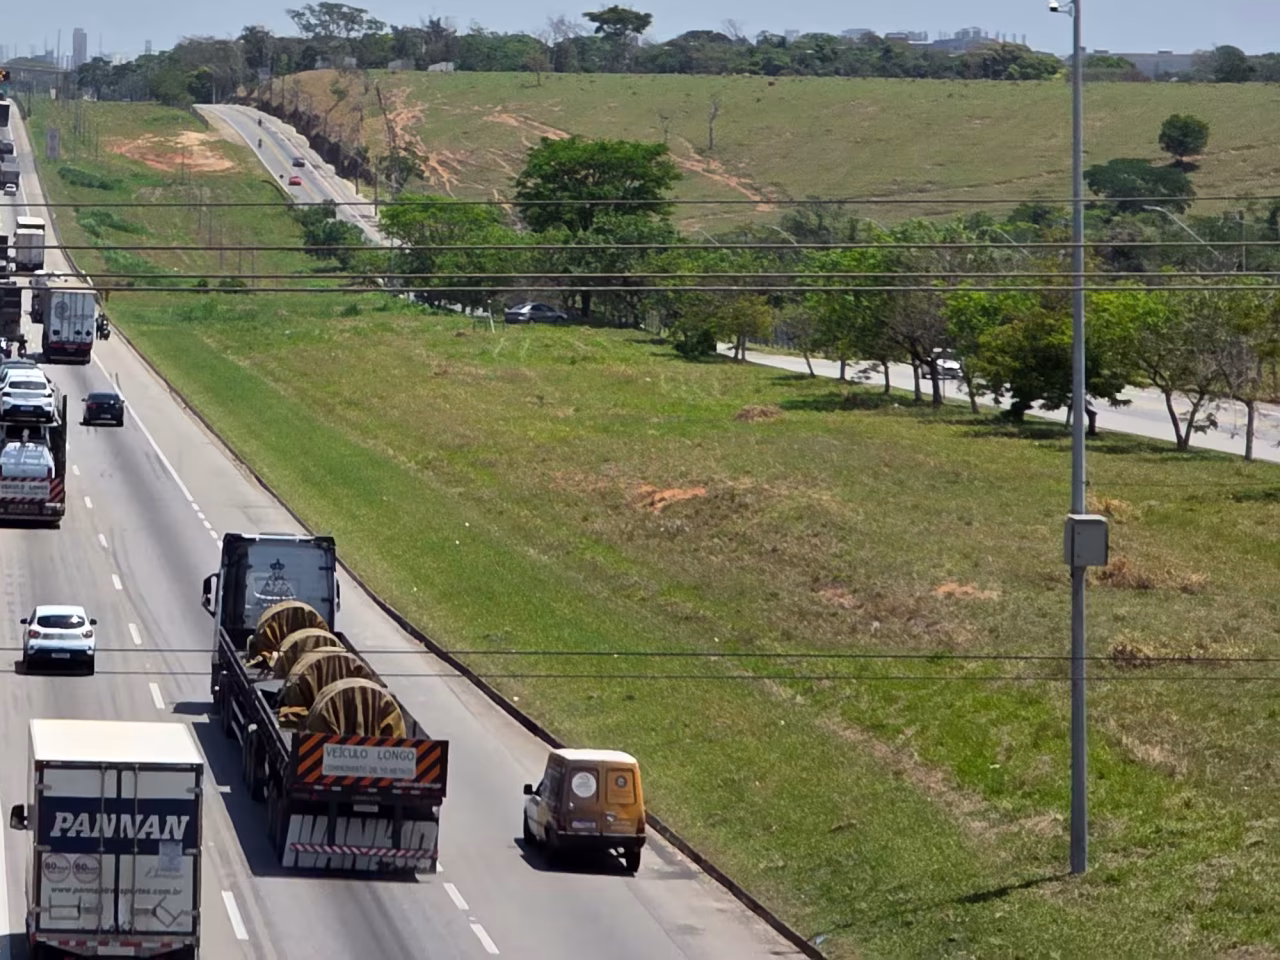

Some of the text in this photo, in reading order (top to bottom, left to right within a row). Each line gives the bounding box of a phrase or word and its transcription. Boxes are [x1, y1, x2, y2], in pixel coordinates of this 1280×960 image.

[326, 746, 415, 761] VEÍCULO LONGO
[50, 812, 190, 840] PANNAN
